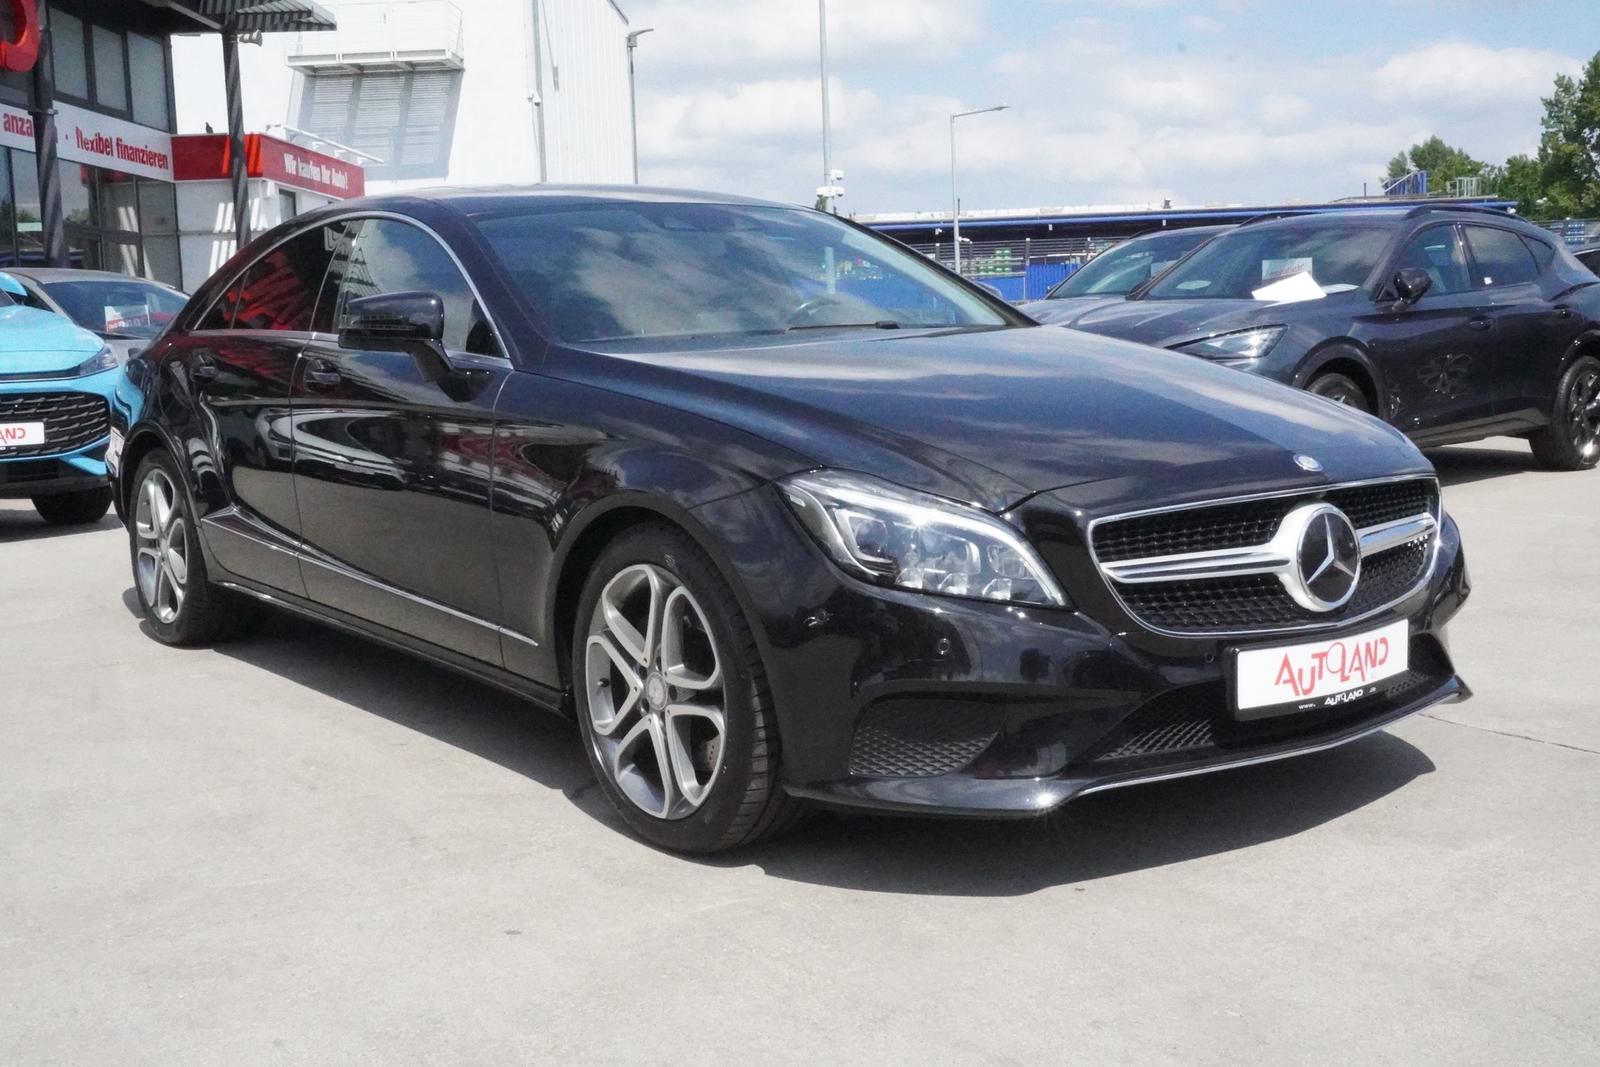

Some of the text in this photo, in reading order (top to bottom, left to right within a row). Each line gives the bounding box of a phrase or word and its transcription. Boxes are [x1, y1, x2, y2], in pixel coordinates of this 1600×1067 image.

[75, 126, 114, 157] flexibel
[115, 137, 169, 170] finanzieren
[1275, 636, 1389, 697] AUTOLAND
